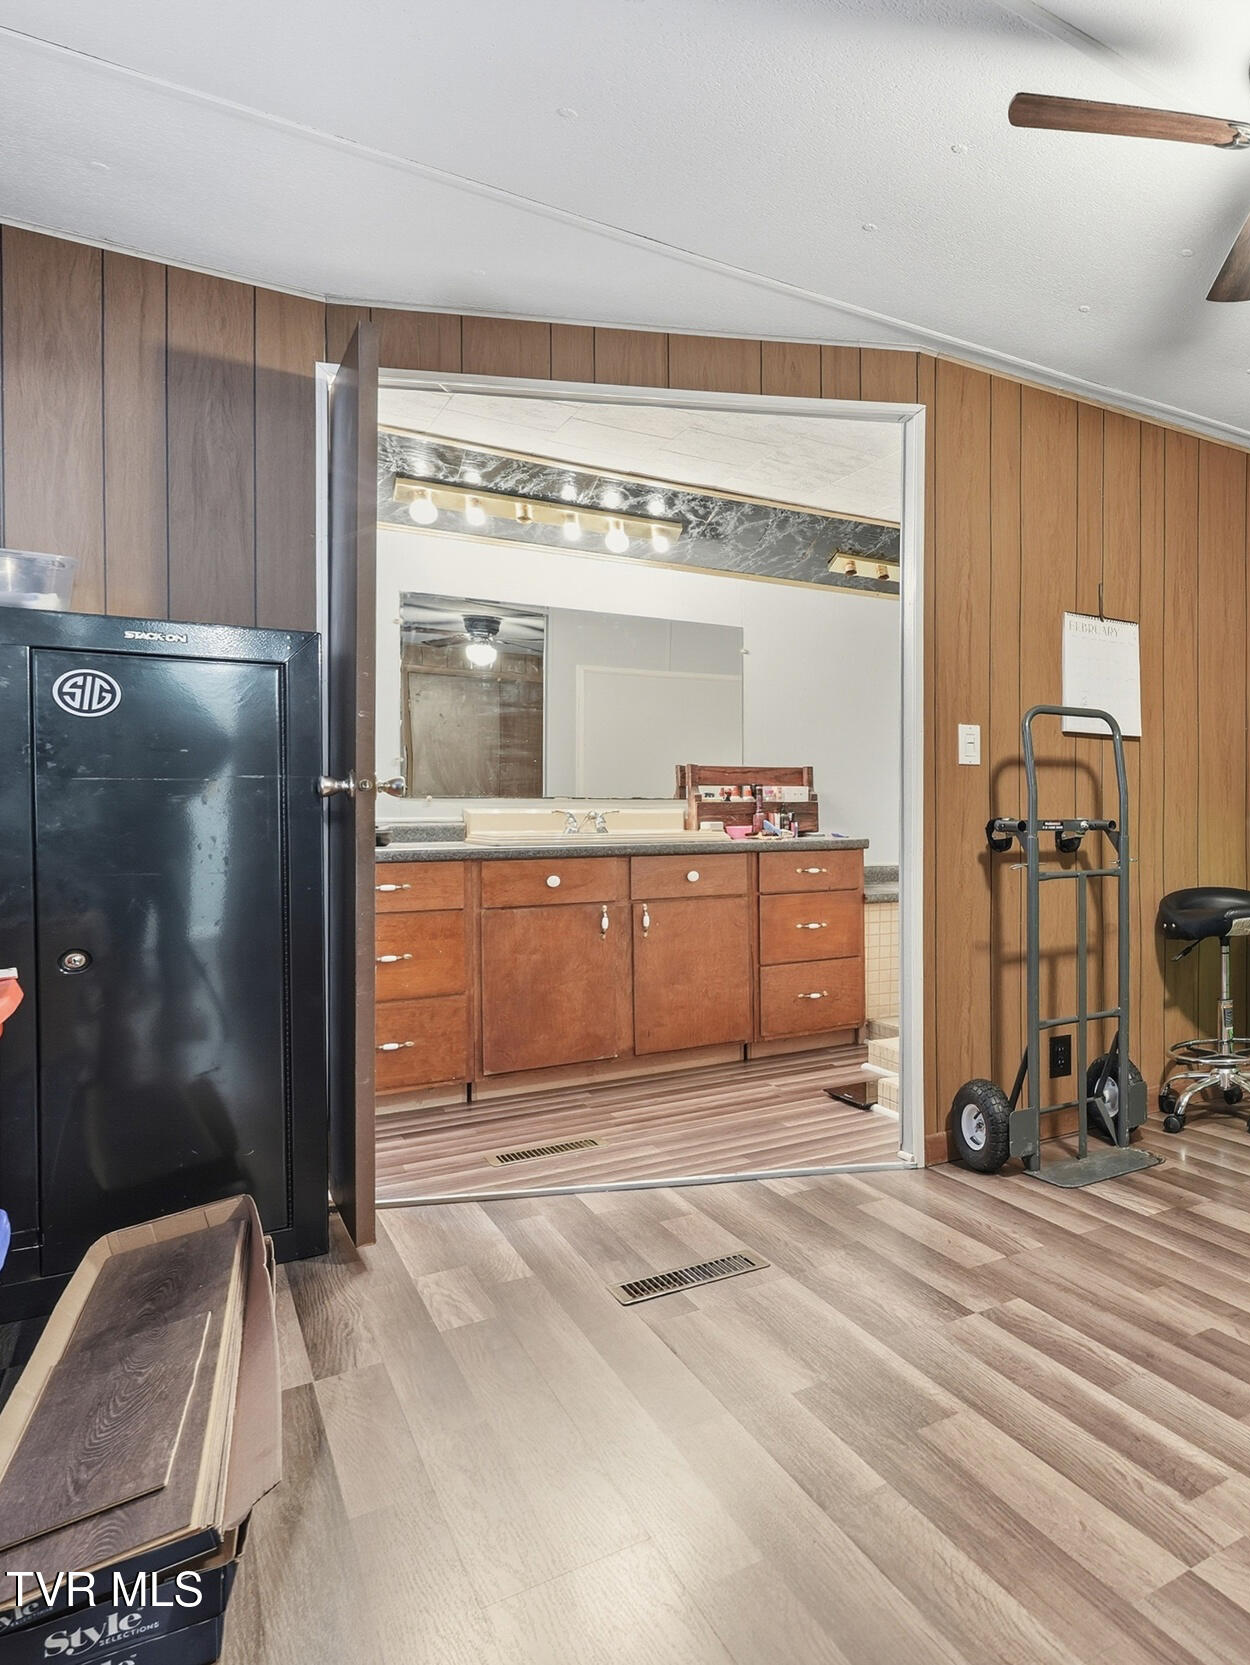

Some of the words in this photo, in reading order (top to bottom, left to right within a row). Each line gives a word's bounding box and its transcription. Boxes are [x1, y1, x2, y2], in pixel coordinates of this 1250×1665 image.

[124, 631, 187, 643] STACK-ON
[1069, 620, 1118, 637] FEBRUARY
[61, 674, 113, 712] SIG
[44, 1611, 143, 1658] Style
[99, 1621, 160, 1647] SELECTIONS
